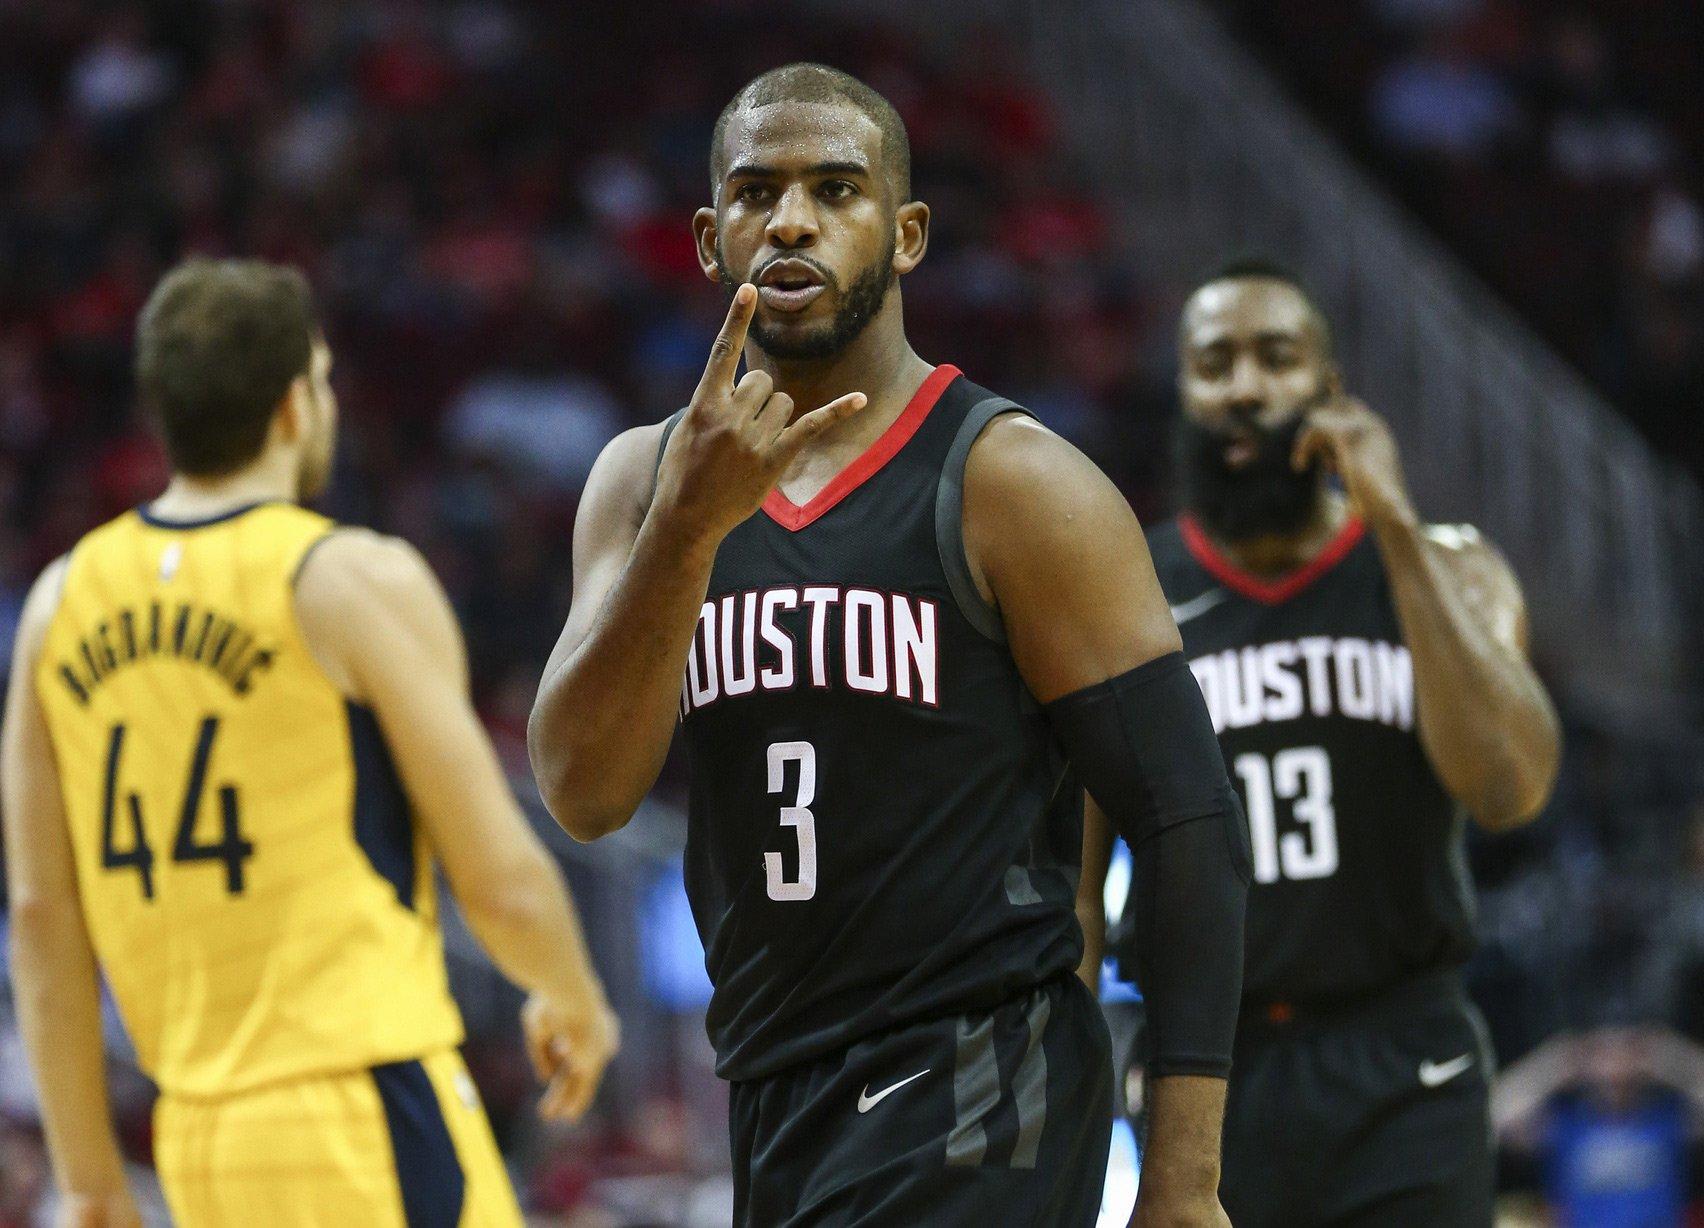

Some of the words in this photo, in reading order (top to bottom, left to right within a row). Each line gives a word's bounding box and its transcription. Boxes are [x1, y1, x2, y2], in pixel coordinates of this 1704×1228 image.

[679, 584, 938, 723] OUSTON
[101, 715, 254, 903] 44
[765, 741, 817, 901] 3
[1235, 745, 1339, 884] 13
